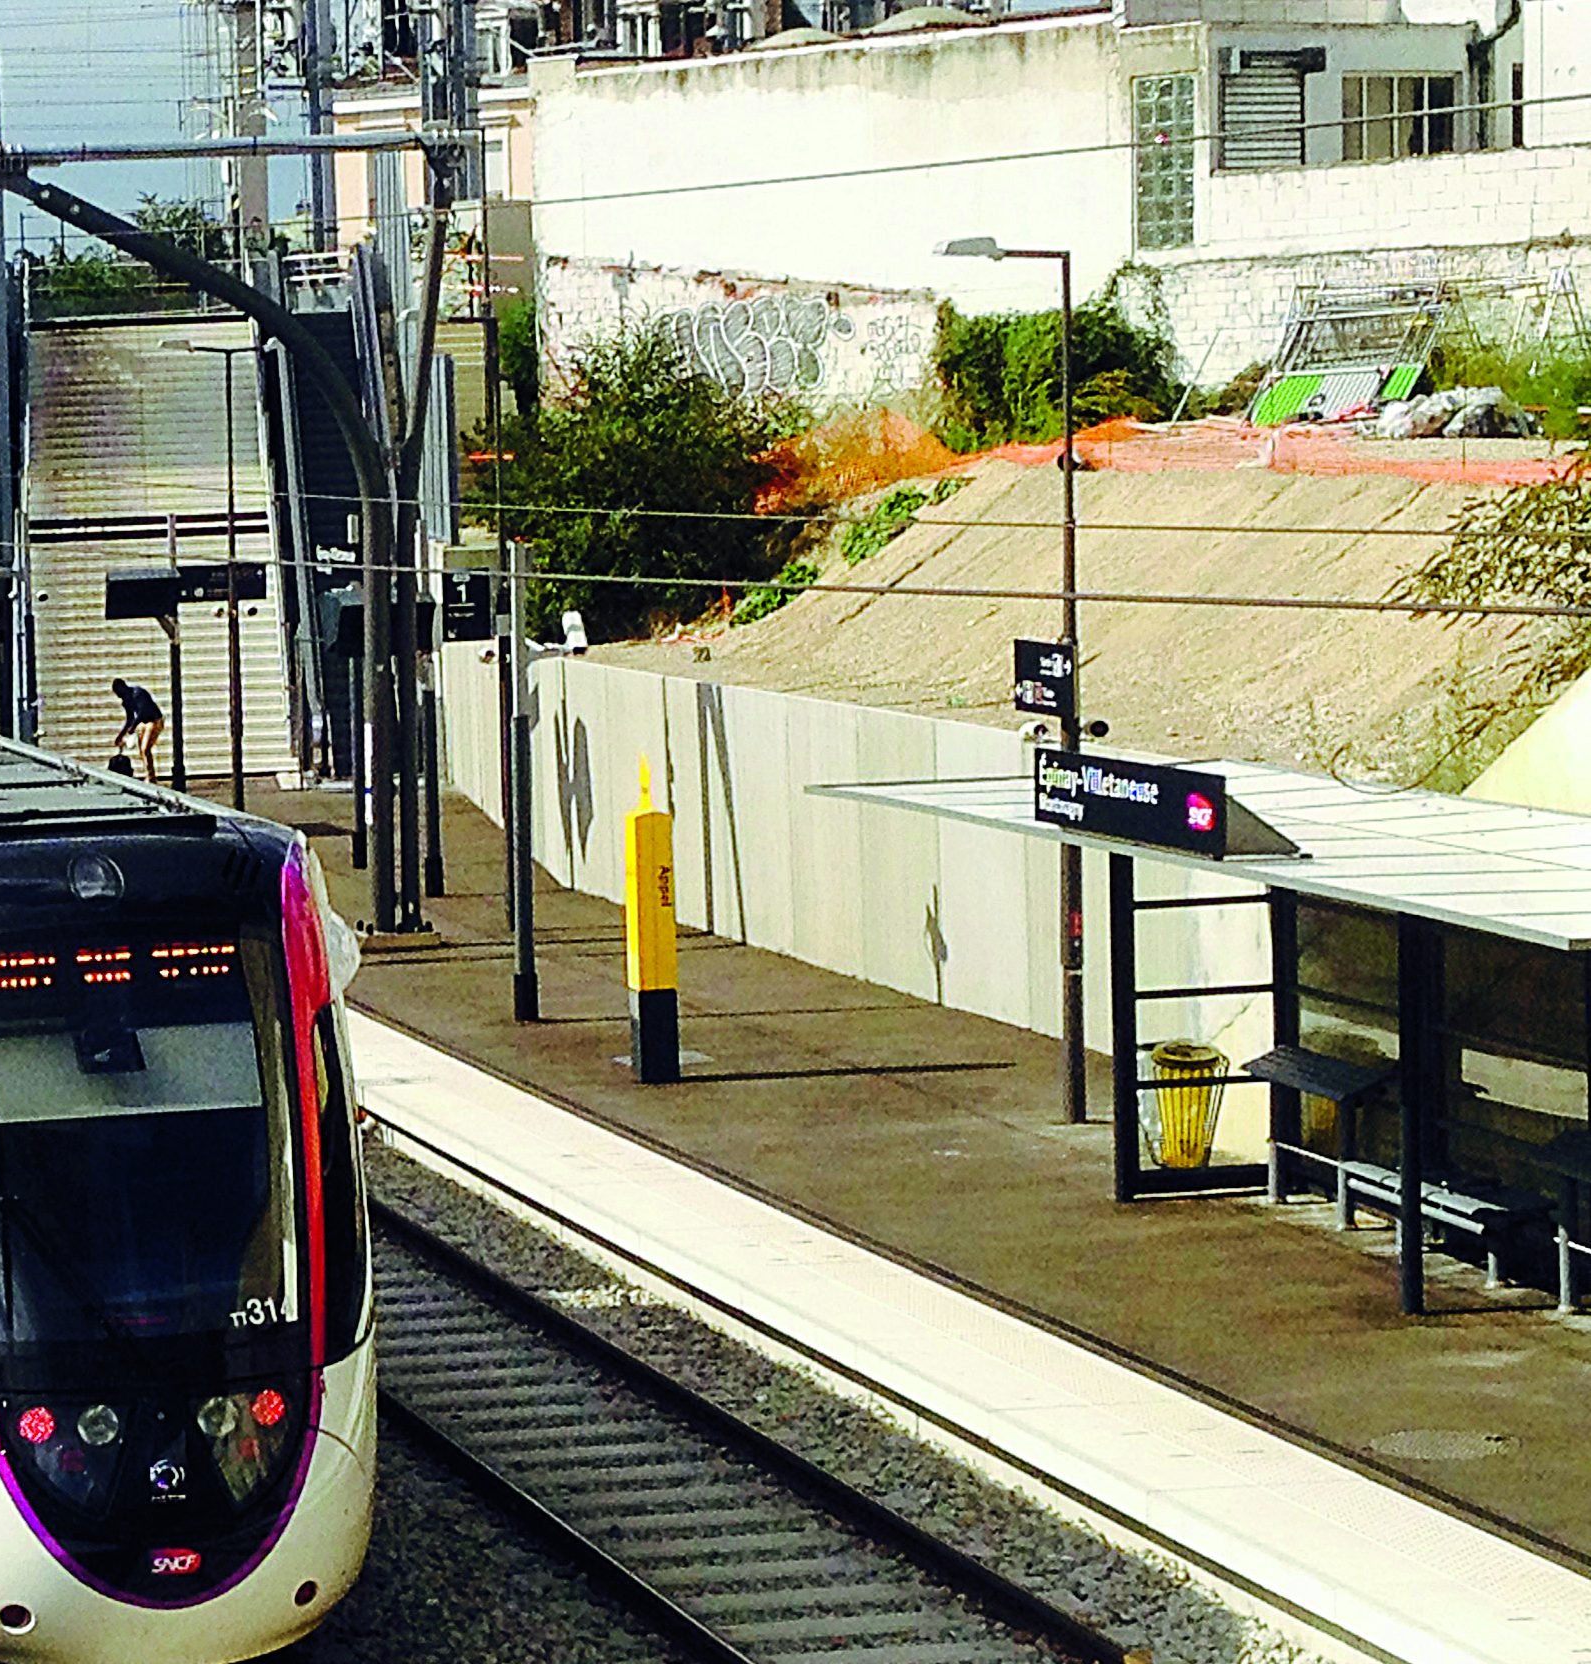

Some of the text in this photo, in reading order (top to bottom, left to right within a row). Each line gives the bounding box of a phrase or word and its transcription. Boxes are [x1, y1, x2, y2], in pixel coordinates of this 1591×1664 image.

[456, 583, 466, 603] 1
[657, 865, 673, 907] Appel
[151, 1553, 200, 1573] SNCF
